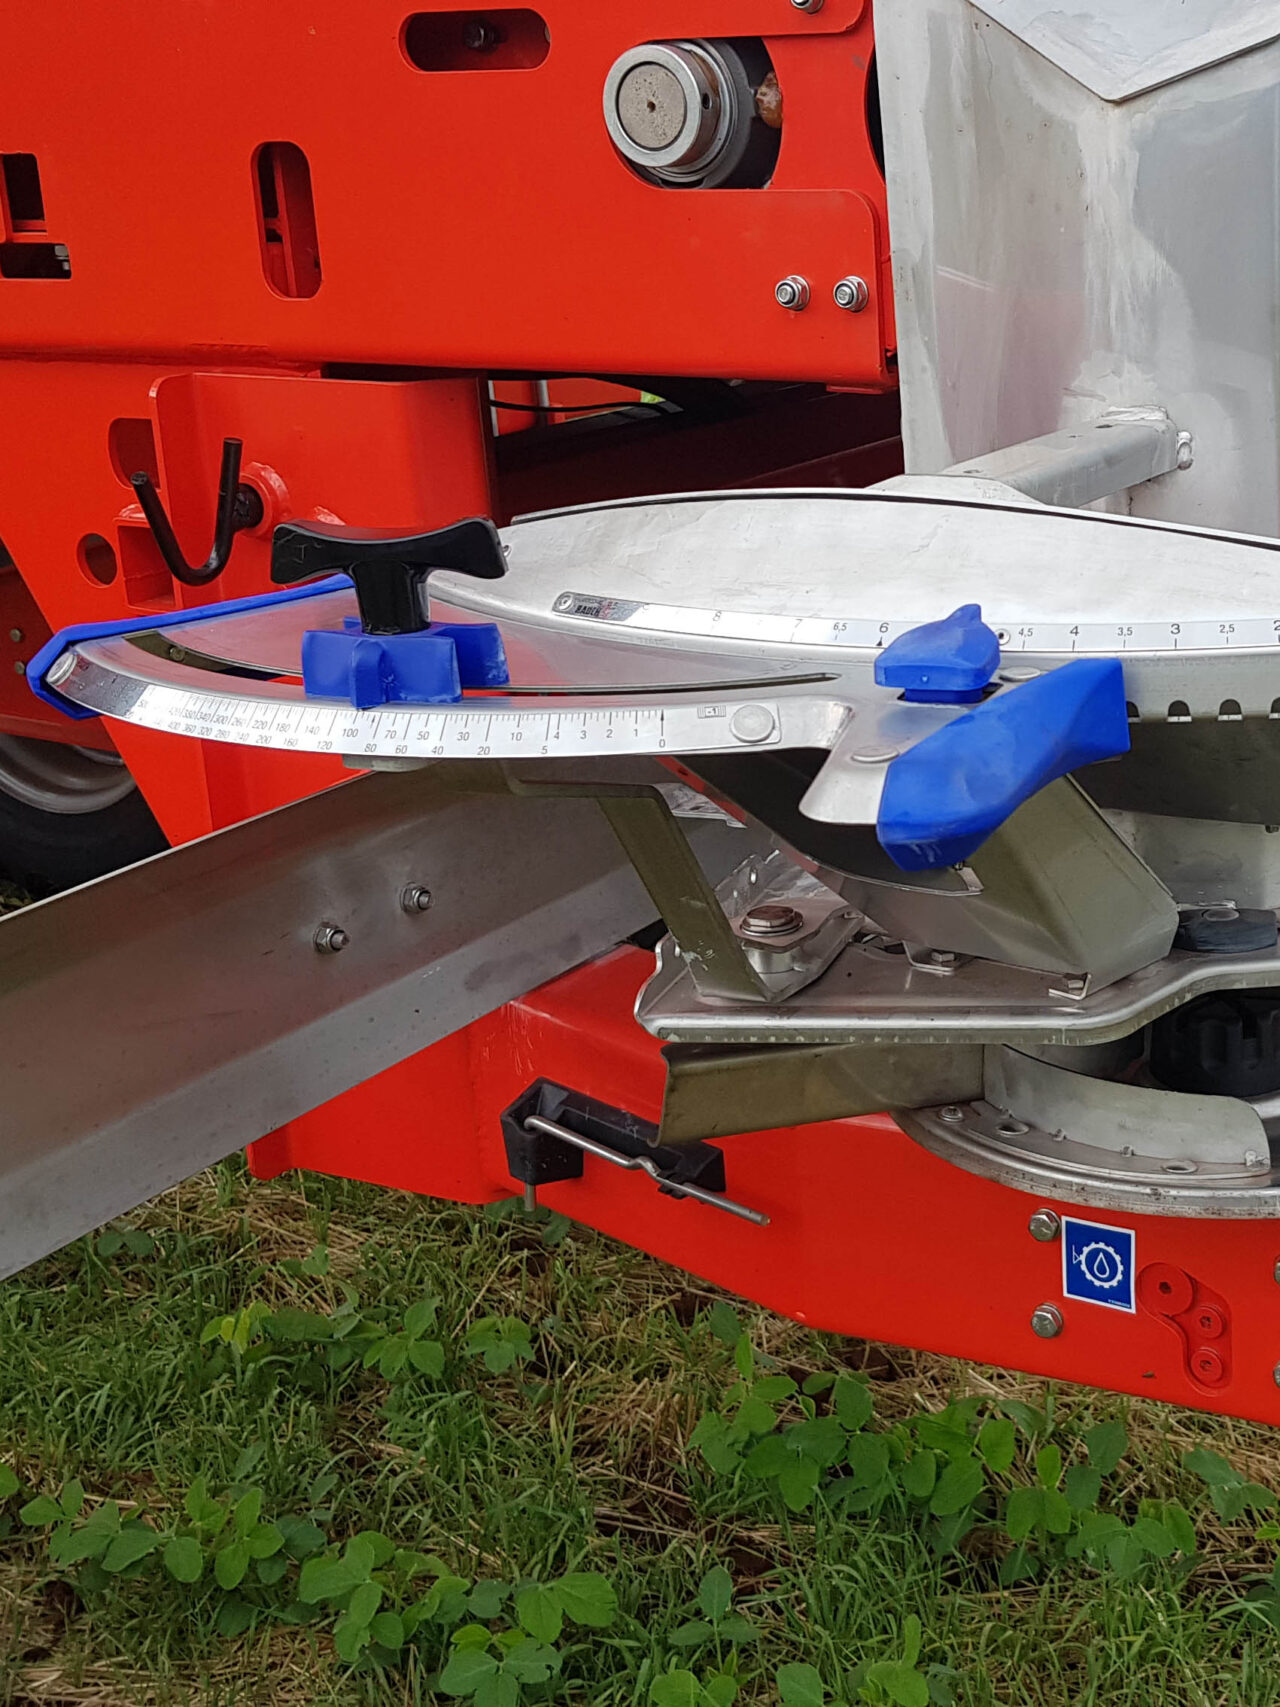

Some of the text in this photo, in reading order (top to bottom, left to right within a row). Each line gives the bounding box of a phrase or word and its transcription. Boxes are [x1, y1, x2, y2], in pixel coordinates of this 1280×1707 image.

[712, 610, 722, 622] 8
[795, 618, 802, 628] 7
[833, 622, 848, 633] 6,5
[879, 622, 890, 634] 6
[1018, 628, 1033, 638] 4,5
[1070, 625, 1080, 636] 4
[1117, 626, 1133, 638] 3,5
[1170, 624, 1181, 635] 3
[1219, 624, 1235, 635] 2,5
[197, 726, 212, 736] 320
[256, 734, 272, 744] 200
[284, 738, 298, 748] 160
[316, 740, 332, 750] 120
[364, 743, 378, 753] 80
[395, 744, 408, 754] 60
[431, 746, 444, 755] 40
[477, 746, 490, 756] 20
[541, 746, 548, 754] 5
[658, 739, 666, 748] 0
[213, 714, 228, 726] 300
[252, 720, 268, 730] 220
[276, 722, 290, 732] 180
[305, 726, 320, 736] 140
[343, 728, 358, 738] 100
[384, 730, 397, 740] 70
[416, 730, 430, 740] 50
[457, 732, 470, 742] 30
[510, 732, 522, 742] 10
[554, 732, 560, 740] 4
[580, 730, 587, 740] 3
[606, 729, 612, 738] 2
[634, 728, 638, 737] 1
